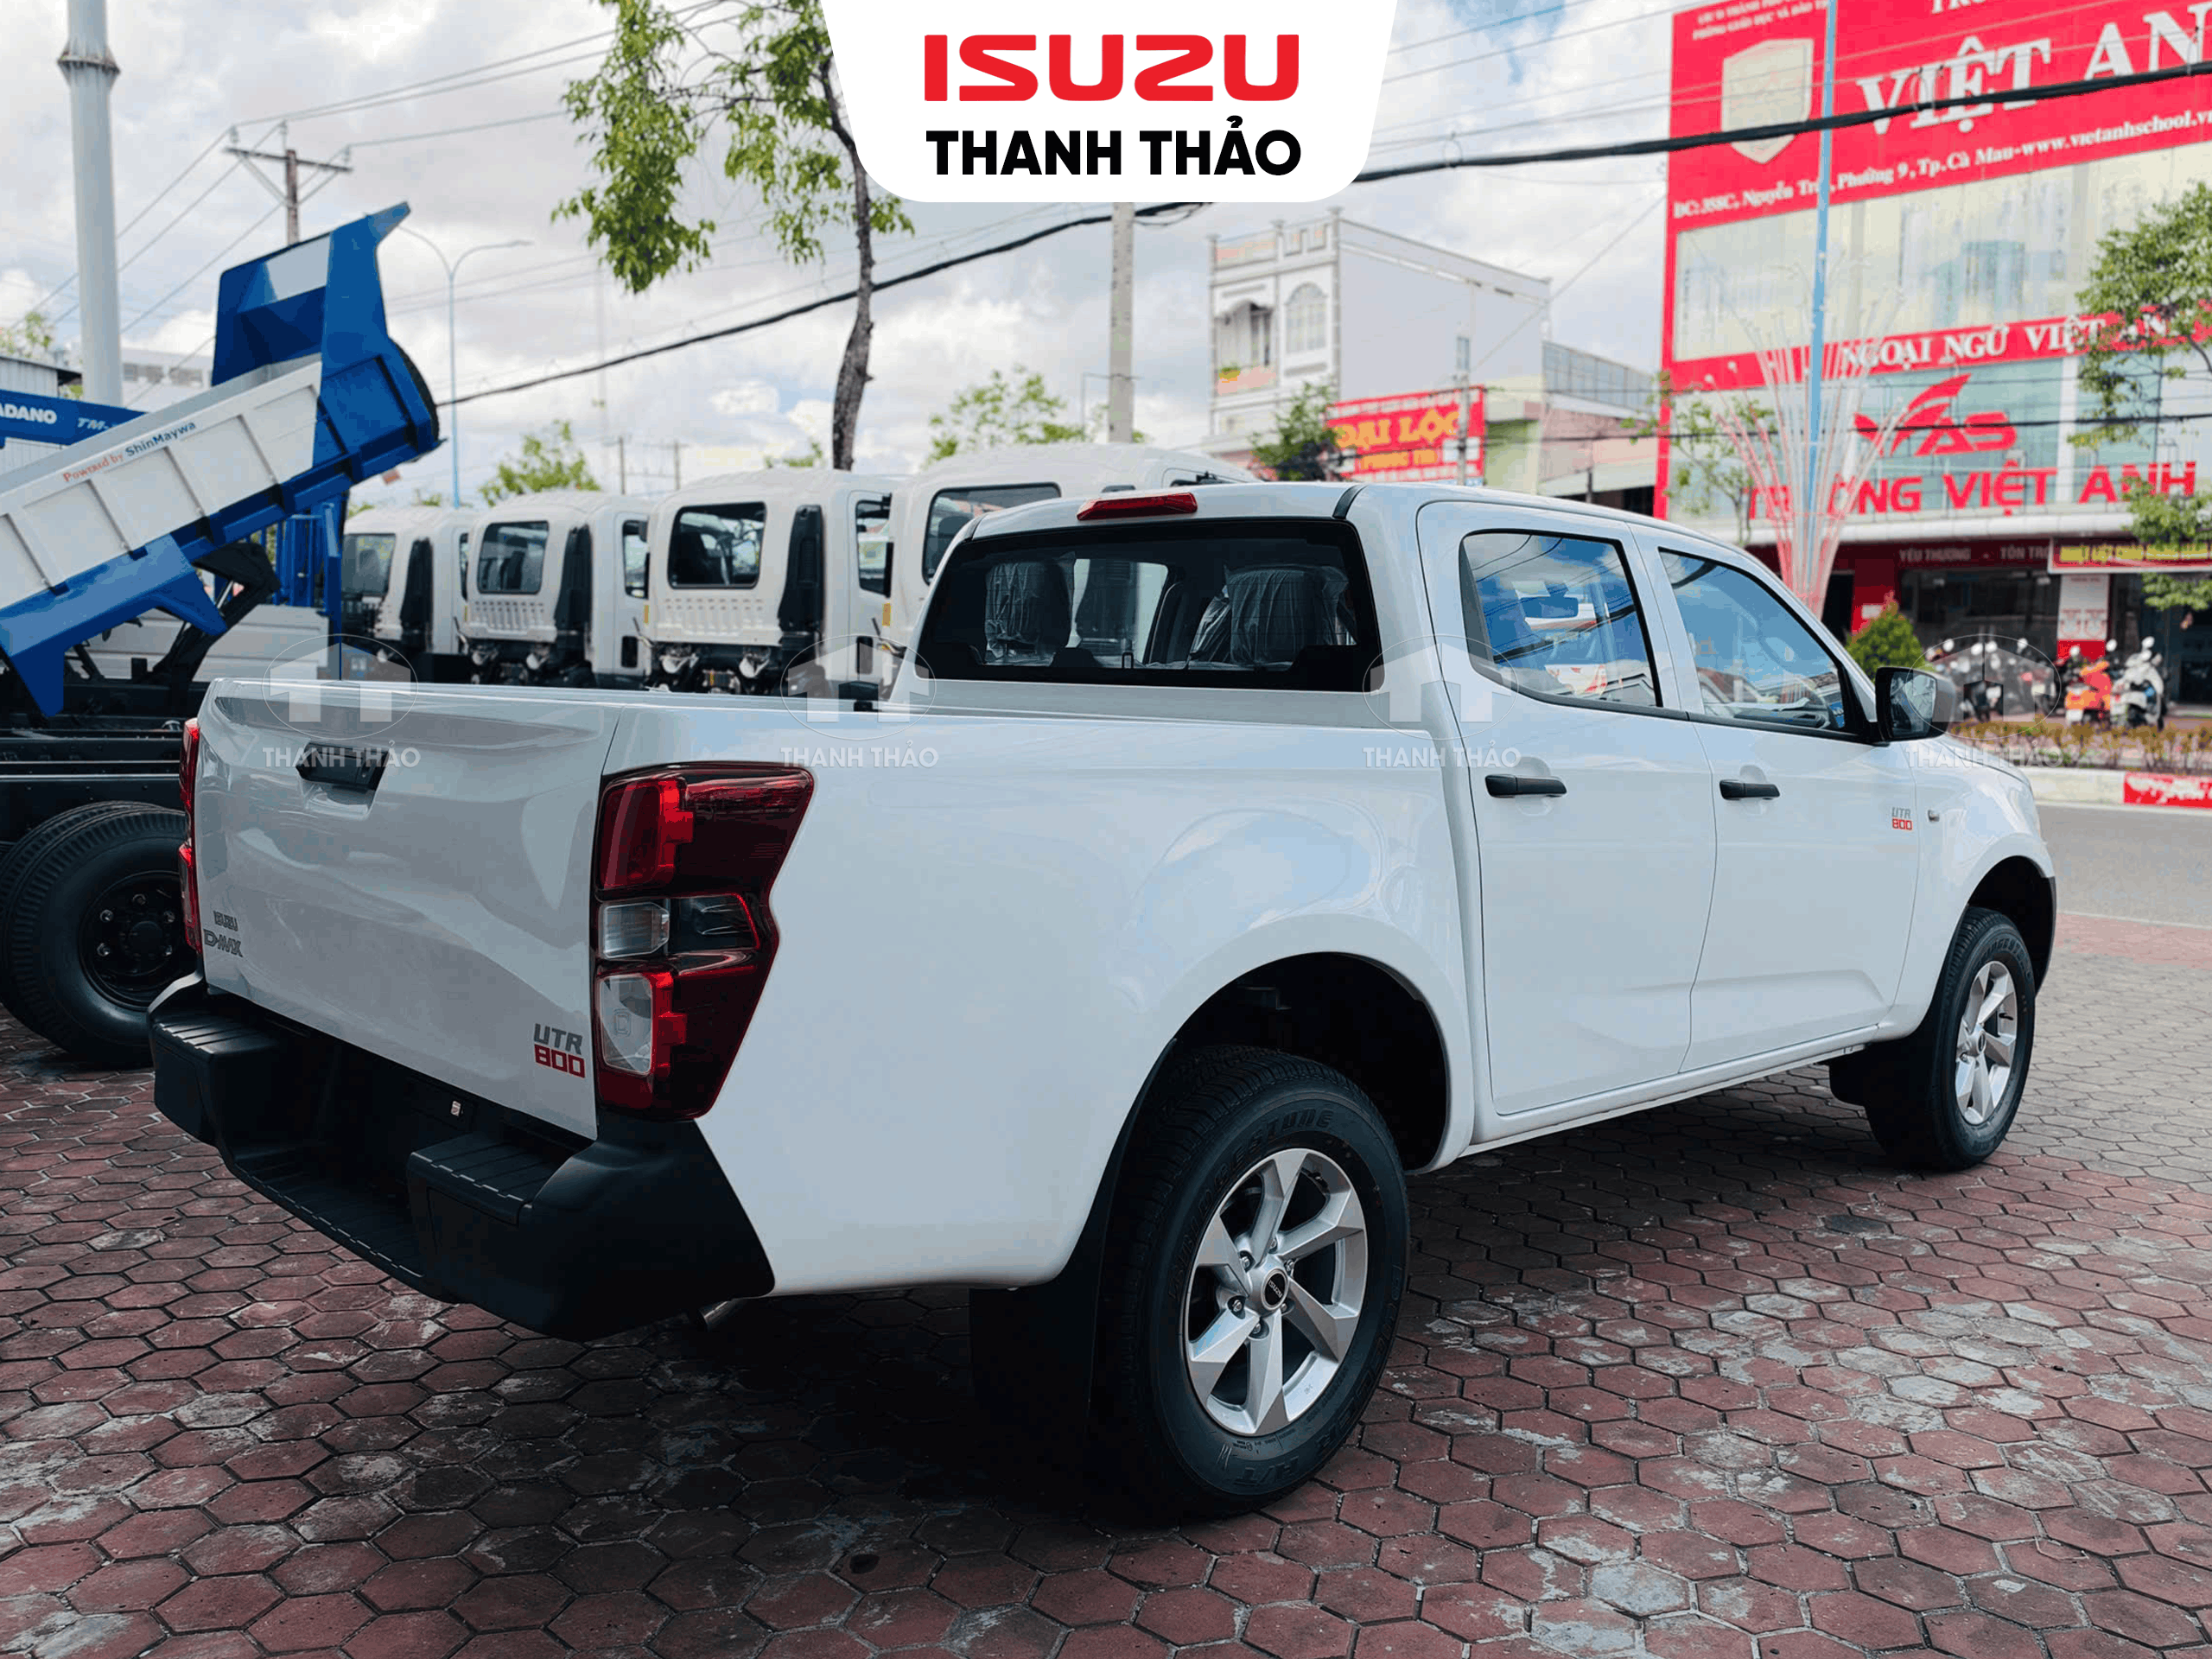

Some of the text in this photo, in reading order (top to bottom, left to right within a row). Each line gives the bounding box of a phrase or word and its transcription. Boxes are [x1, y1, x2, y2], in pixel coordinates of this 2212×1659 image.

[1855, 35, 2051, 136] VIỆT
[1942, 325, 2010, 361] NGỮ
[62, 460, 110, 483] Powered
[124, 421, 196, 457] ShinMaywa
[1942, 459, 2057, 517] VIỆT
[2077, 461, 2196, 504] ANH
[1891, 806, 1911, 819] UTR
[1891, 817, 1913, 831] 800
[533, 1022, 583, 1056] UTR
[534, 1043, 586, 1079] 800
